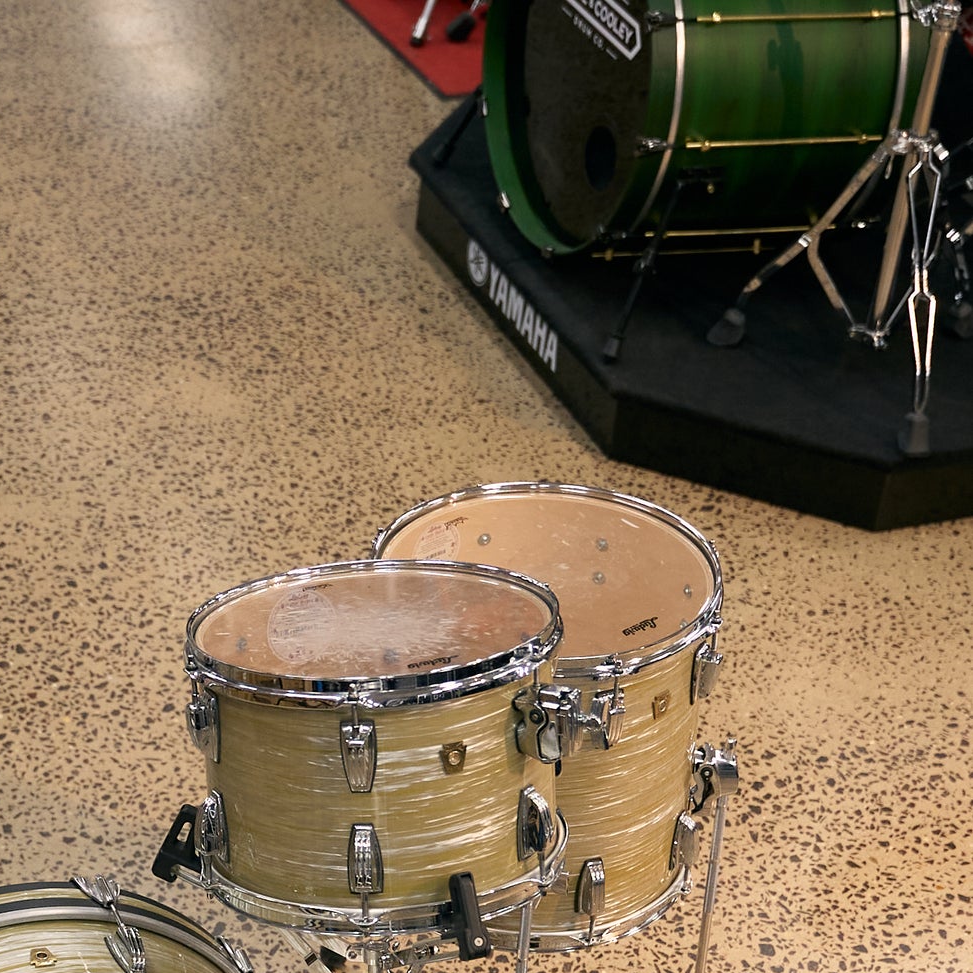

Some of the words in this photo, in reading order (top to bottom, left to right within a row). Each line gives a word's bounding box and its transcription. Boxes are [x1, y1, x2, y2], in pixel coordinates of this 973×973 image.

[594, 1, 634, 44] COOLEY
[489, 261, 558, 374] YAMAHA
[621, 616, 658, 636] Ludwig
